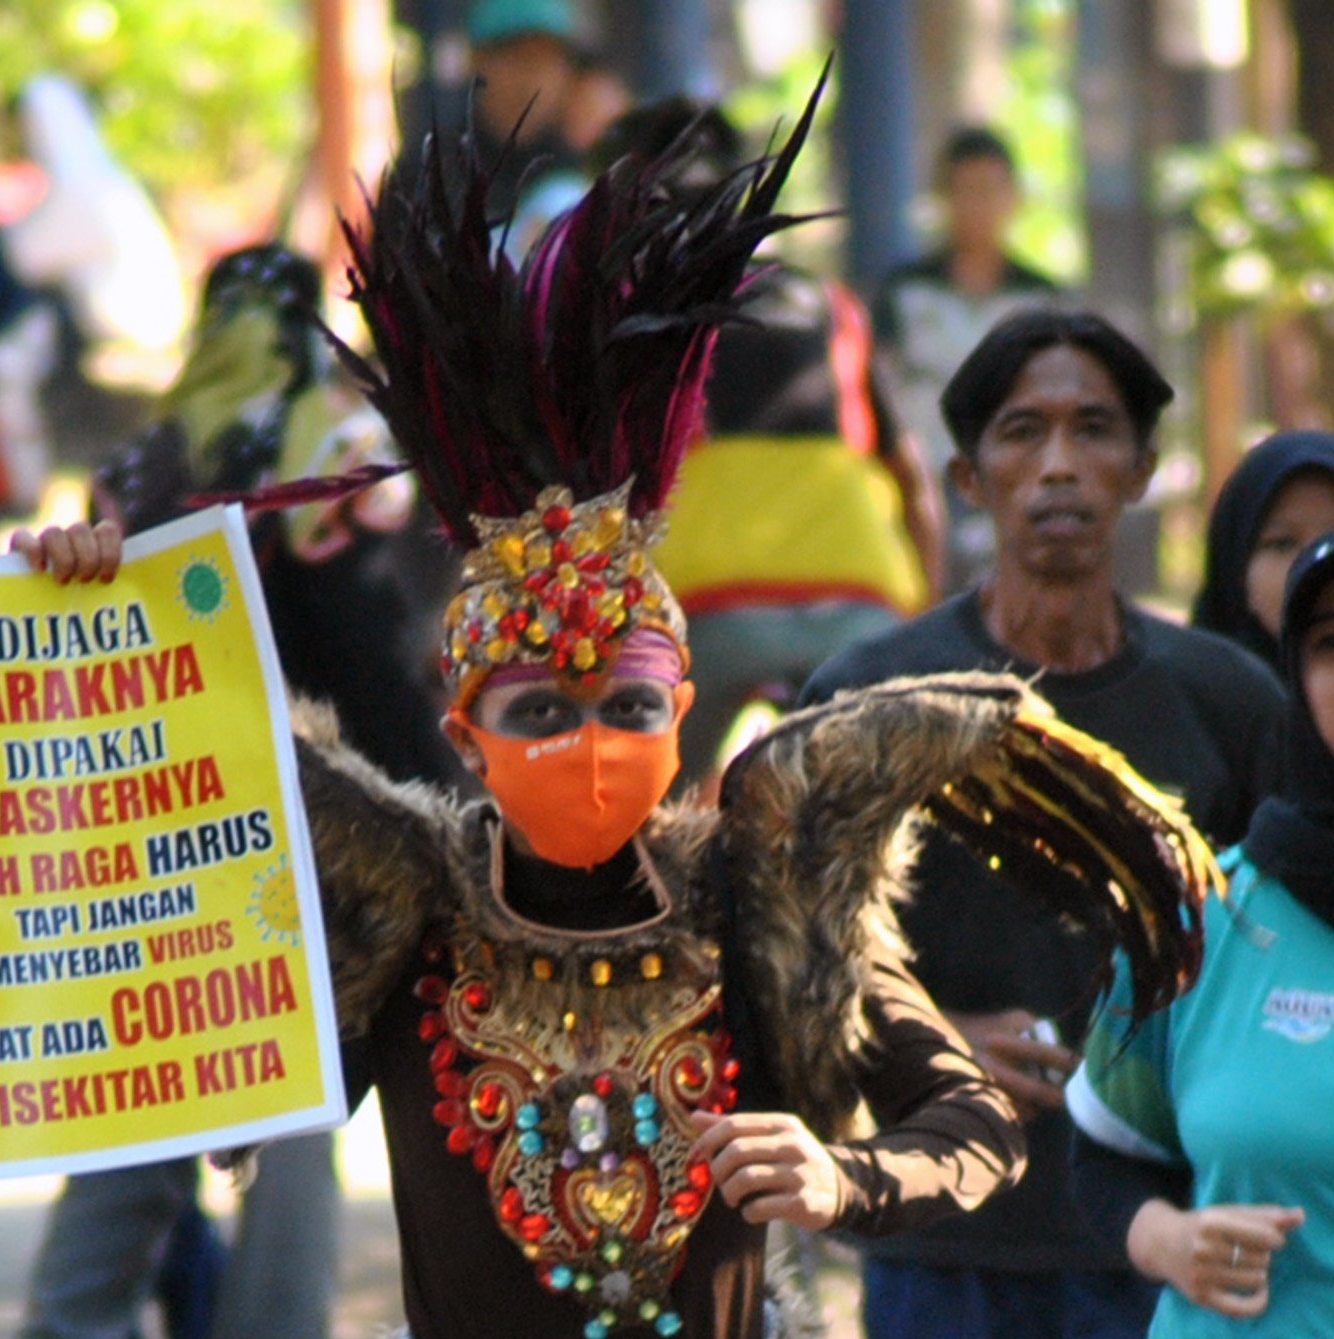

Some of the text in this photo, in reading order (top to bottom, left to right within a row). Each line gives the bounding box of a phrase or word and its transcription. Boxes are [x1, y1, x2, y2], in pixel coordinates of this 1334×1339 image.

[3, 719, 165, 780] DIPAKAI
[31, 842, 139, 894] RAGA
[146, 809, 273, 878] HARUS
[15, 883, 195, 939] TAPI JANGAN
[147, 920, 234, 965] VIRUS
[41, 1017, 108, 1058] ADA
[111, 954, 298, 1047] CORONA
[194, 1038, 286, 1097] KITA
